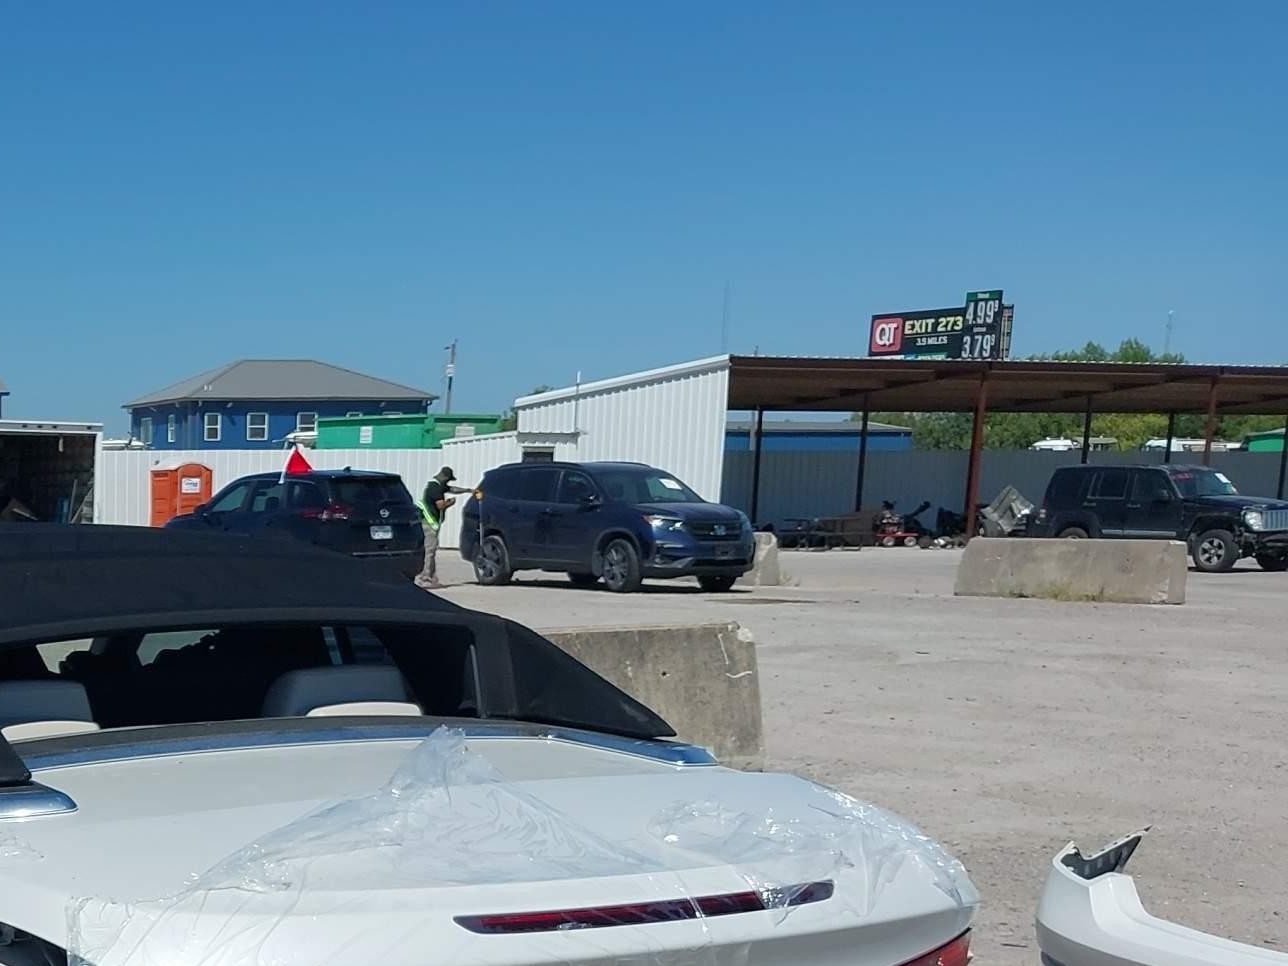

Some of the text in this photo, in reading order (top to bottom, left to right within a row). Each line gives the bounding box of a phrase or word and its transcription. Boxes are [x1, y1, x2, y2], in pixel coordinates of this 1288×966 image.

[904, 315, 964, 334] EXIT 273
[875, 323, 899, 347] QT
[927, 336, 948, 345] MILES
